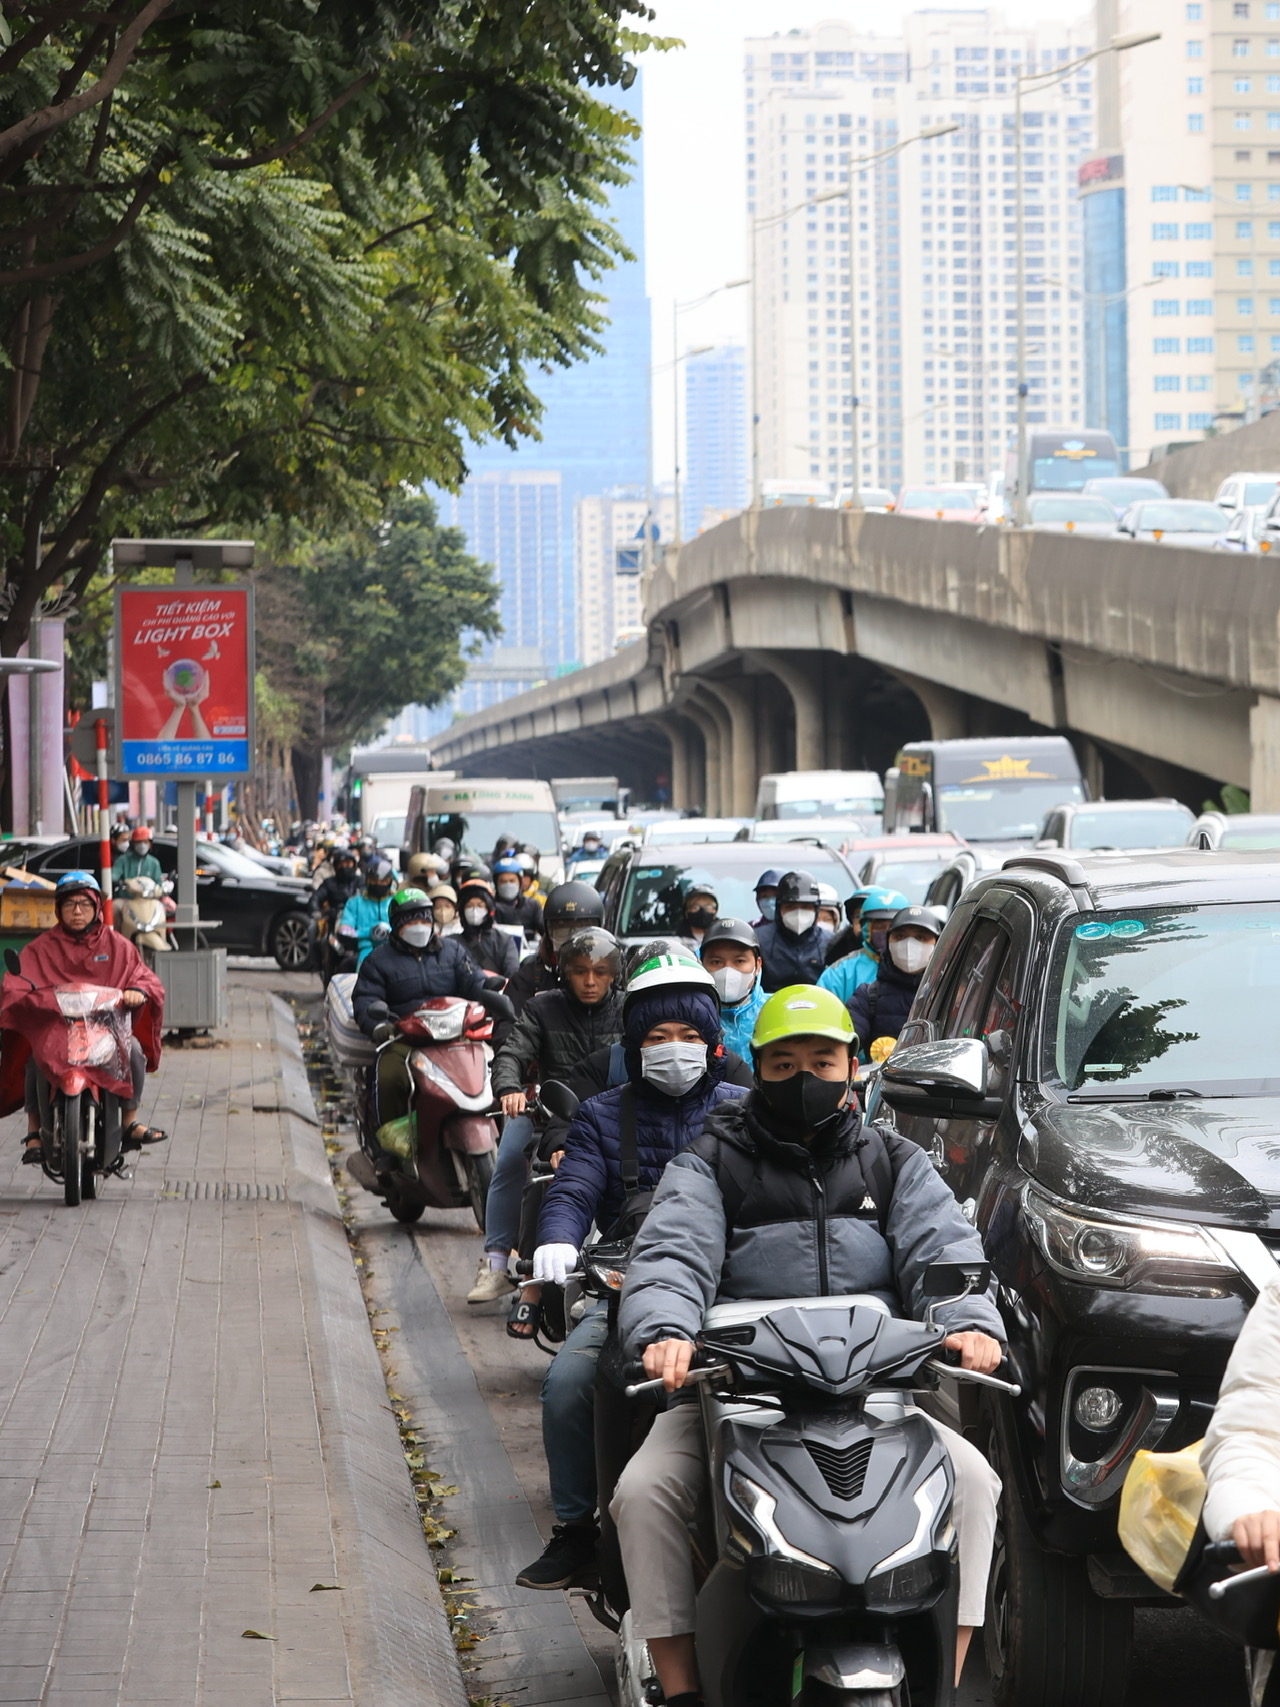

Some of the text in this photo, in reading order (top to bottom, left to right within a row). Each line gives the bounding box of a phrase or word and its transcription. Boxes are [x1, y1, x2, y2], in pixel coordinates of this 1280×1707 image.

[156, 600, 185, 616] TIẾT
[133, 621, 235, 645] LIGHT BOX
[137, 753, 171, 765] 0865
[197, 753, 213, 764] 87
[218, 752, 235, 764] 86
